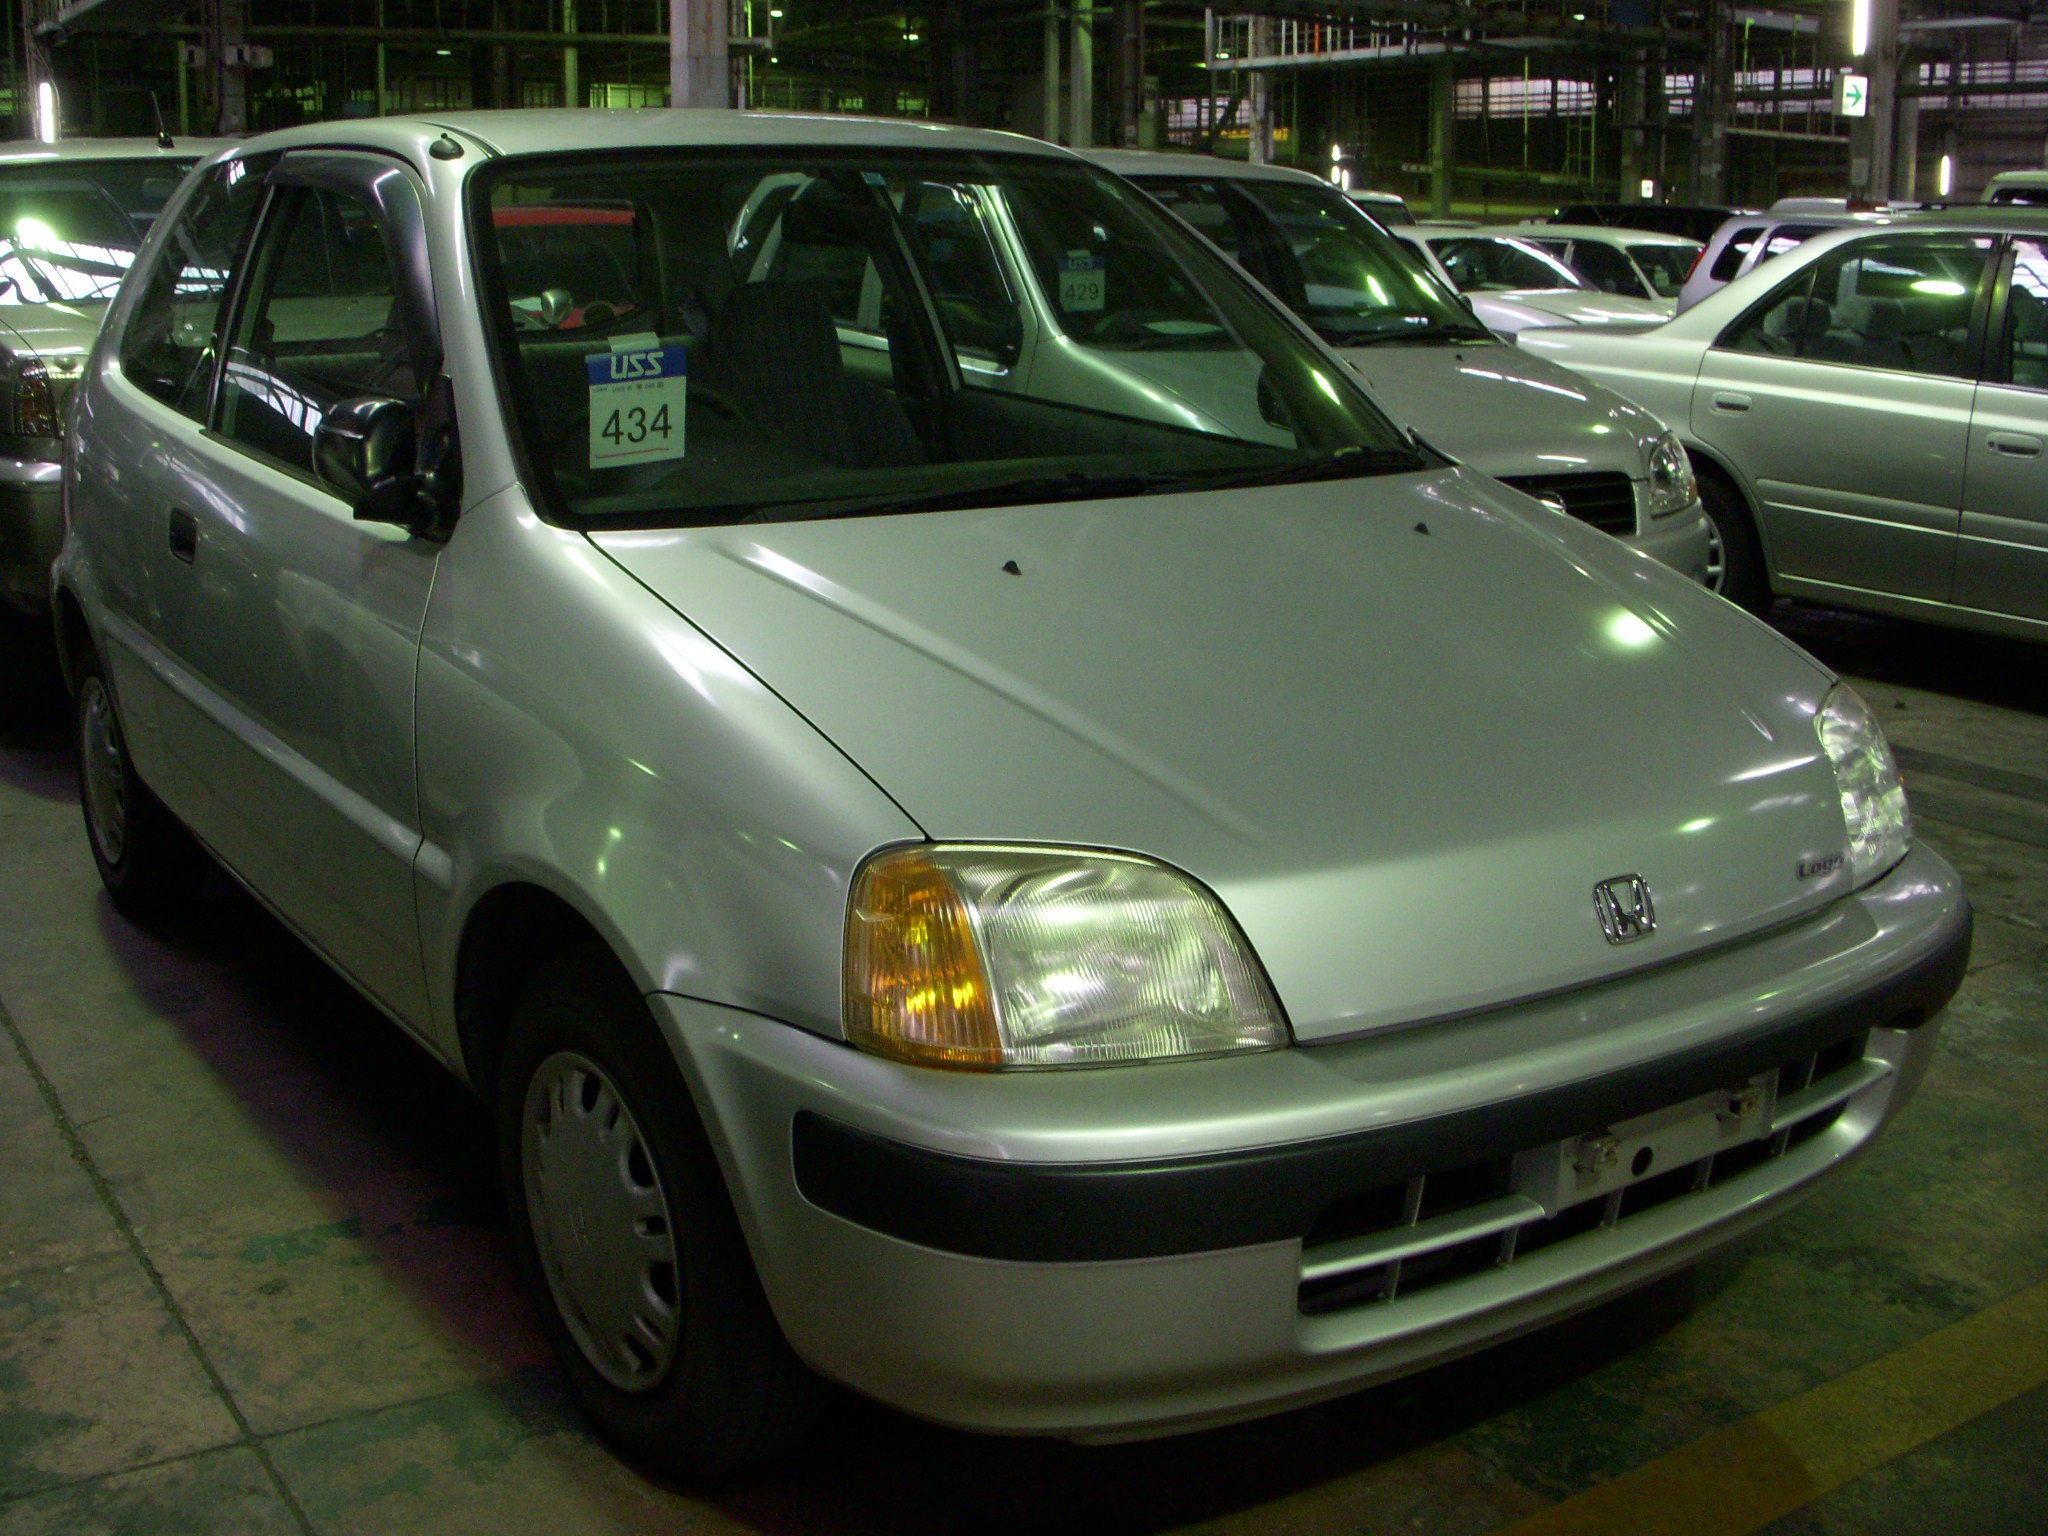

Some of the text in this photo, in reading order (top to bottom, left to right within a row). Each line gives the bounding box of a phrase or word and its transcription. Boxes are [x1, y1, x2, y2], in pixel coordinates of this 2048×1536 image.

[1064, 282, 1099, 303] 429
[610, 351, 664, 380] USS
[601, 403, 672, 446] 434
